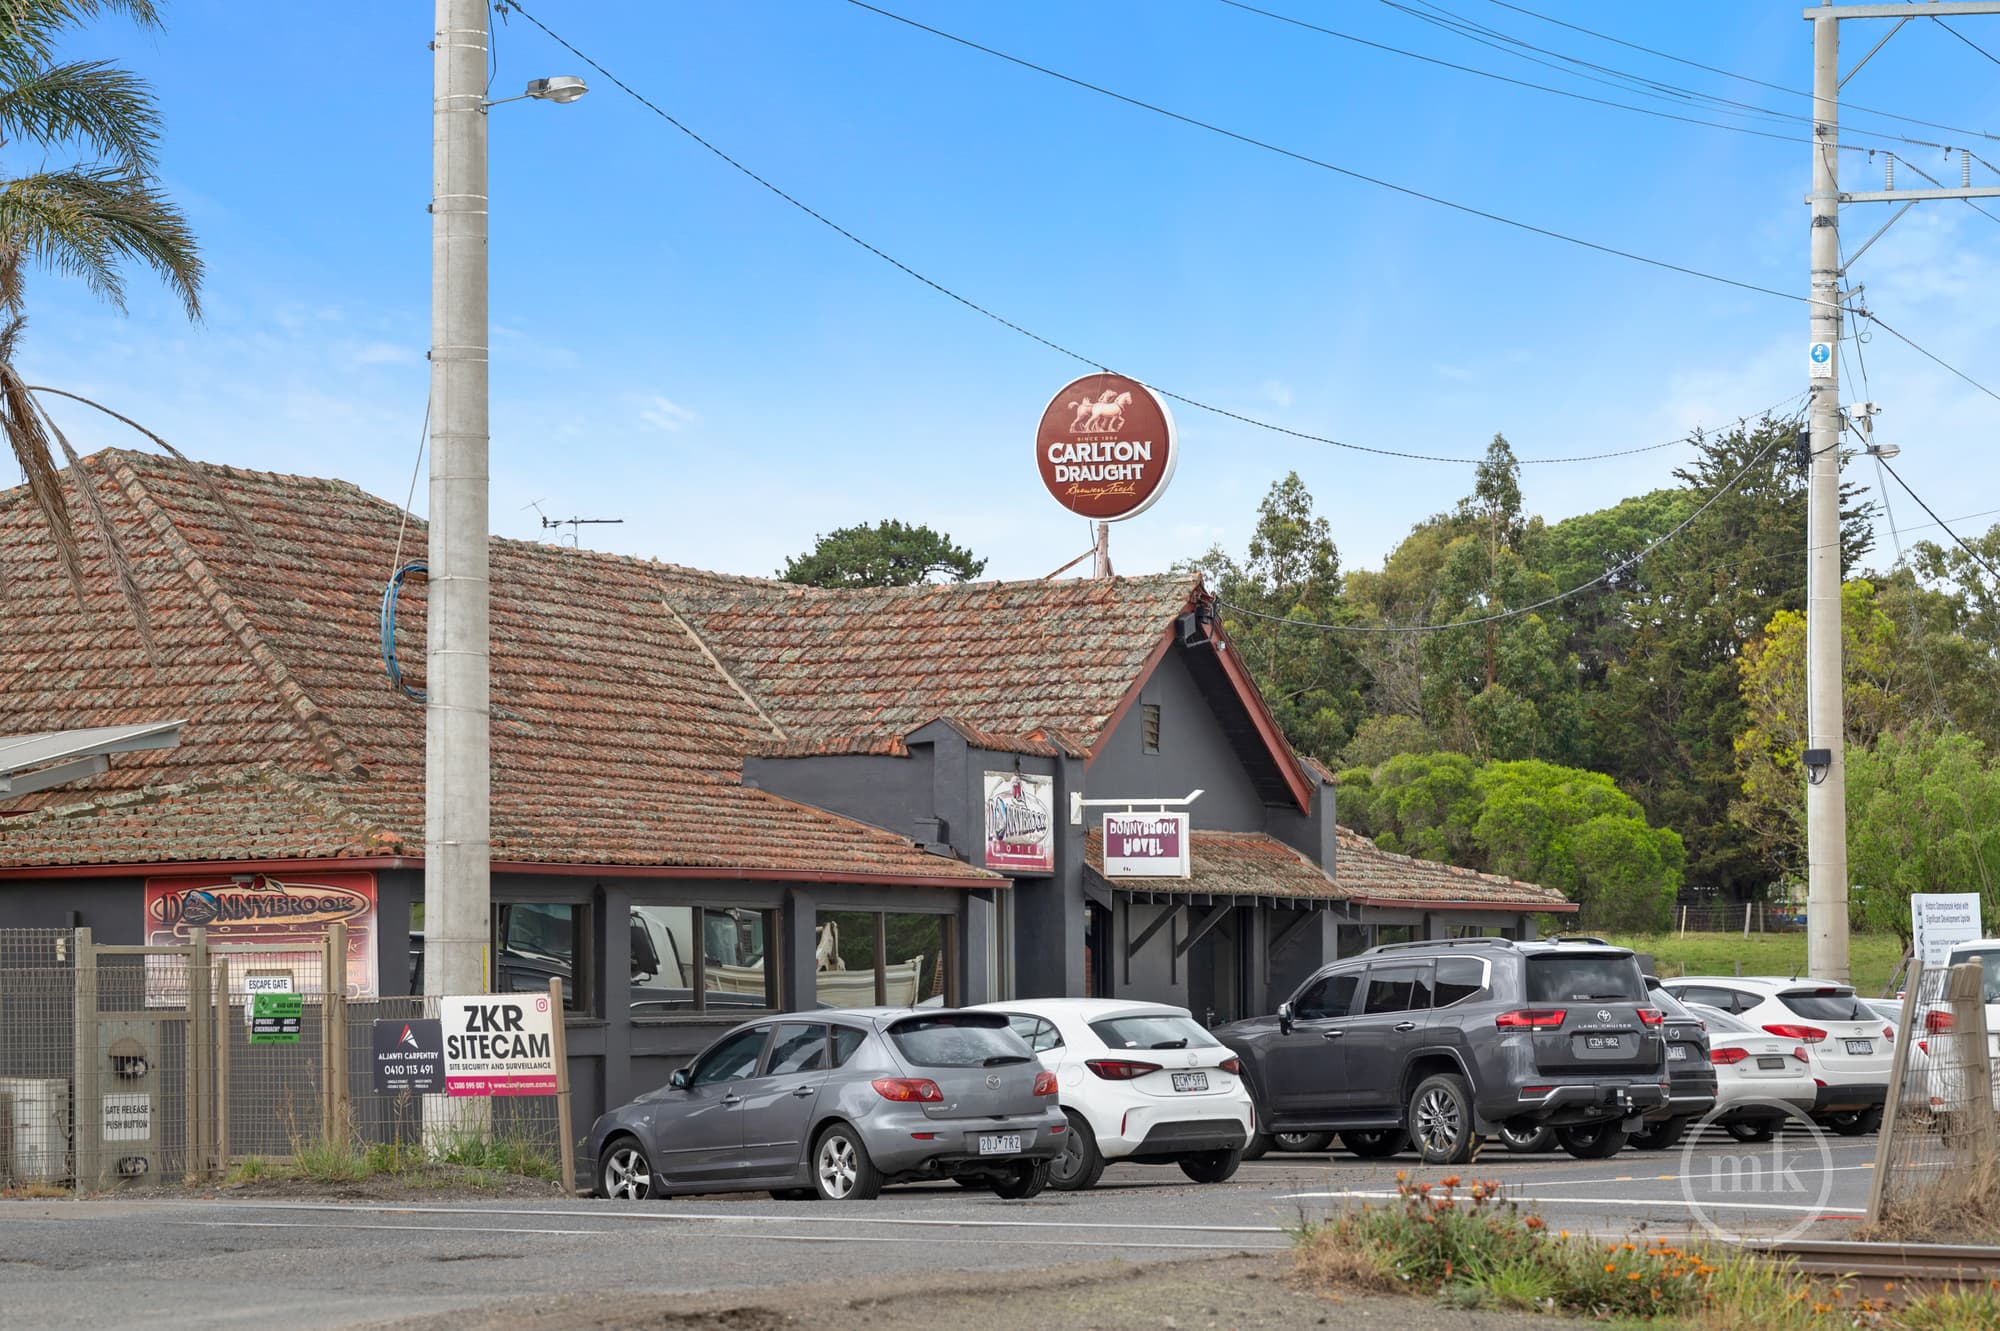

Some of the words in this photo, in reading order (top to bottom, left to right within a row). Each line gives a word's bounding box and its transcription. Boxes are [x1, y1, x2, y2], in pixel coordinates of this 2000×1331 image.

[1047, 440, 1152, 464] CARLTON
[1055, 463, 1145, 483] DRAUGHT
[1065, 483, 1107, 500] Brewery
[1105, 481, 1136, 496] Fresh
[995, 843, 1042, 856] HOTEL
[249, 979, 272, 990] ESCAPE
[272, 979, 288, 989] GATE
[463, 1004, 525, 1033] ZKR
[447, 1033, 551, 1060] SITECAM
[404, 1051, 439, 1060] CARPENTRY
[384, 1065, 405, 1075] 0410
[406, 1064, 418, 1075] 113
[420, 1064, 434, 1074] 491
[449, 1063, 461, 1071] SITE
[462, 1063, 489, 1071] SECURITY
[491, 1062, 505, 1070] AND
[505, 1061, 552, 1070] SURVEILLANCE
[105, 1105, 120, 1115] GATE
[121, 1104, 149, 1114] RELEASE
[105, 1120, 123, 1130] PUSH
[123, 1119, 148, 1129] BUTTON
